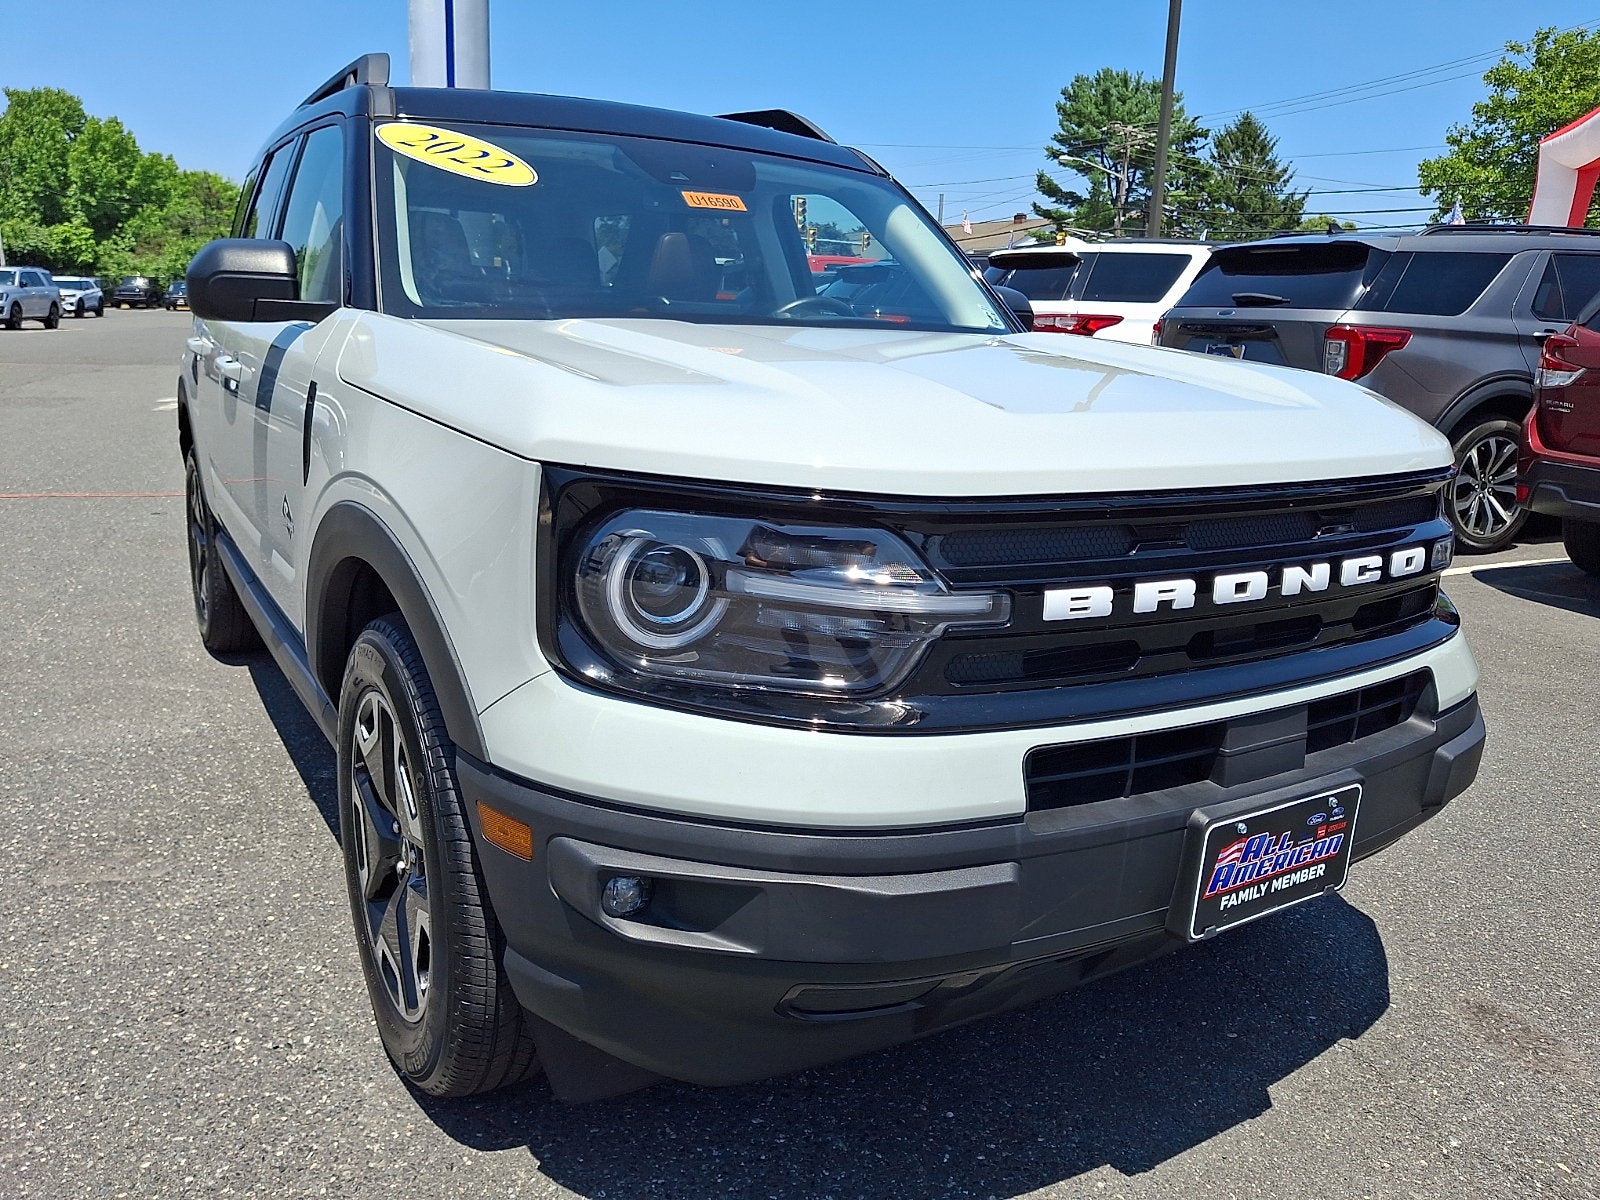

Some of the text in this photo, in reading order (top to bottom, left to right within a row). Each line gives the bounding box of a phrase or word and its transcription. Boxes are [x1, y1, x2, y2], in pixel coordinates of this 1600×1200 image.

[396, 132, 515, 174] 2022
[690, 194, 740, 209] U16590
[1042, 546, 1426, 622] BRONCO
[1205, 832, 1345, 897] AMERICAN
[1219, 863, 1326, 911] FAMILY MEMBER
